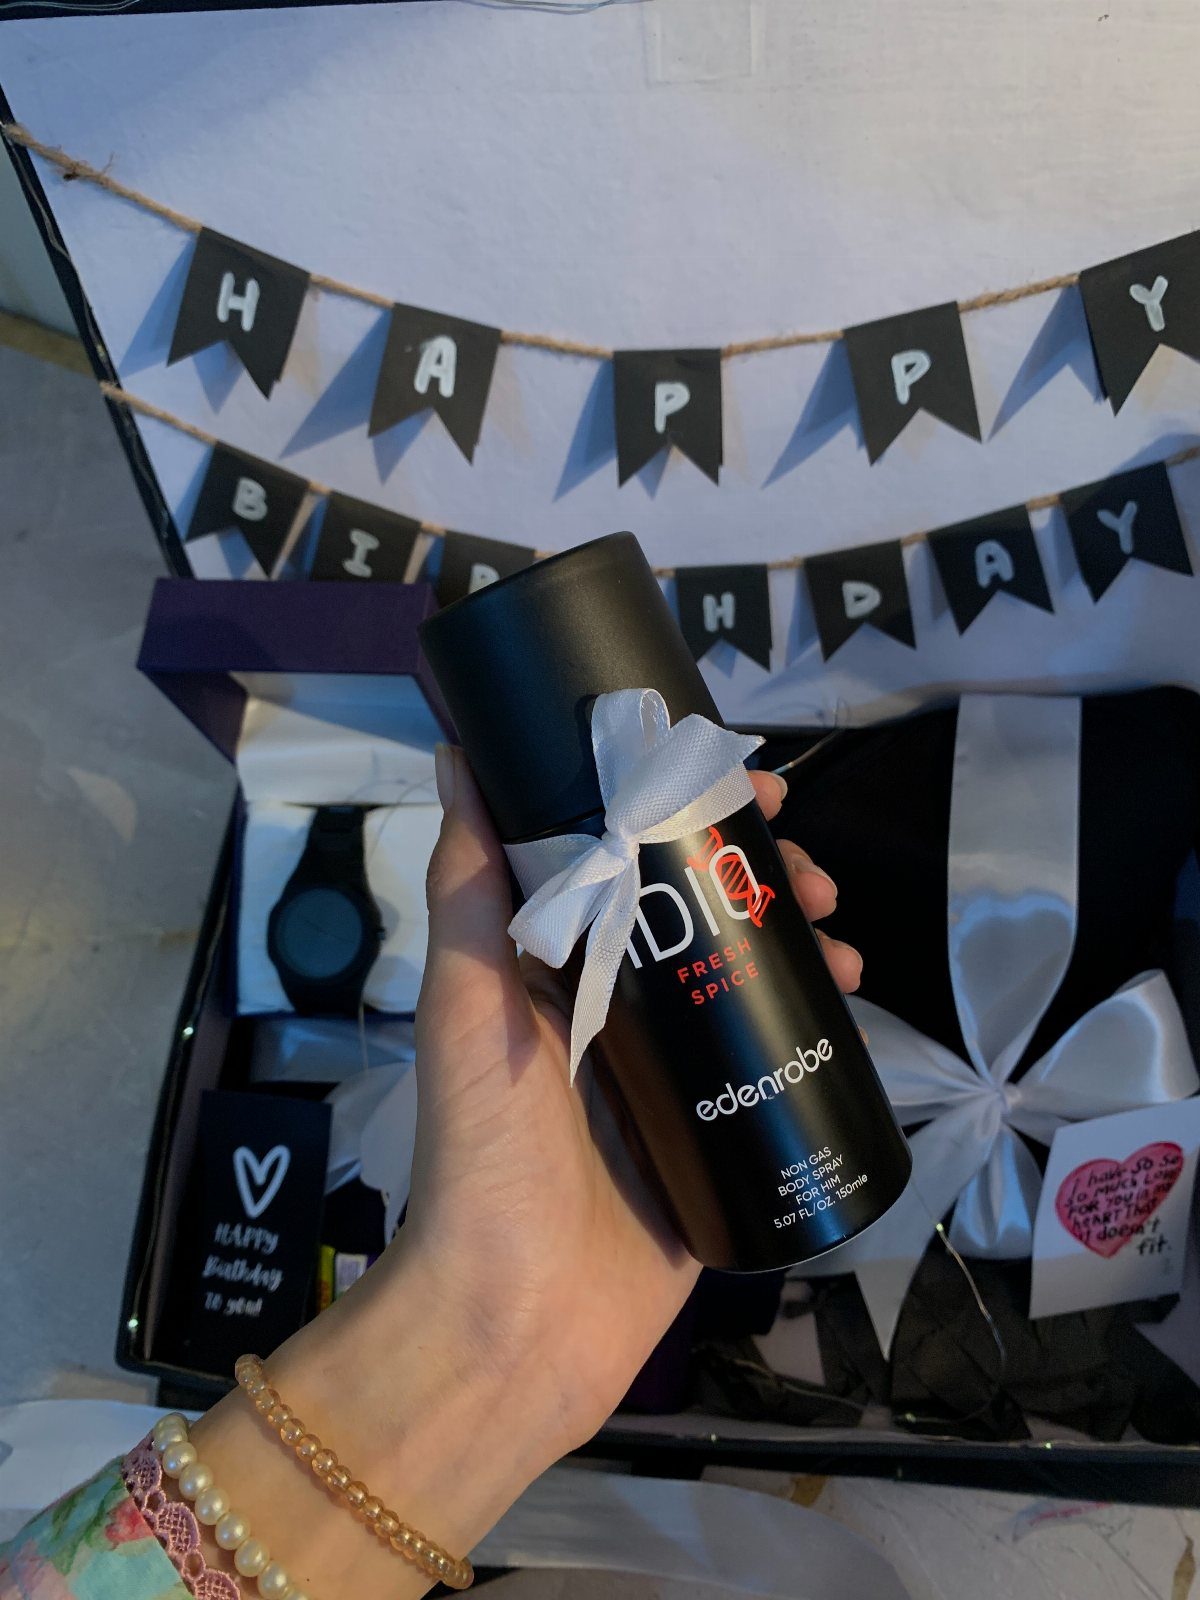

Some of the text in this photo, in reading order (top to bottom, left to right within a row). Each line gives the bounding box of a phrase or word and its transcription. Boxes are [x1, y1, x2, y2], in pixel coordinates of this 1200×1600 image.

[626, 844, 762, 969] DIO
[677, 937, 751, 984] FRESH
[691, 961, 759, 1005] SPICE
[696, 1038, 833, 1121] edenrobe
[778, 1154, 844, 1197] BODY SPRAY
[780, 1146, 832, 1180] NON GAS
[796, 1174, 842, 1205] FOR HIM
[773, 1213, 797, 1229] 5.07
